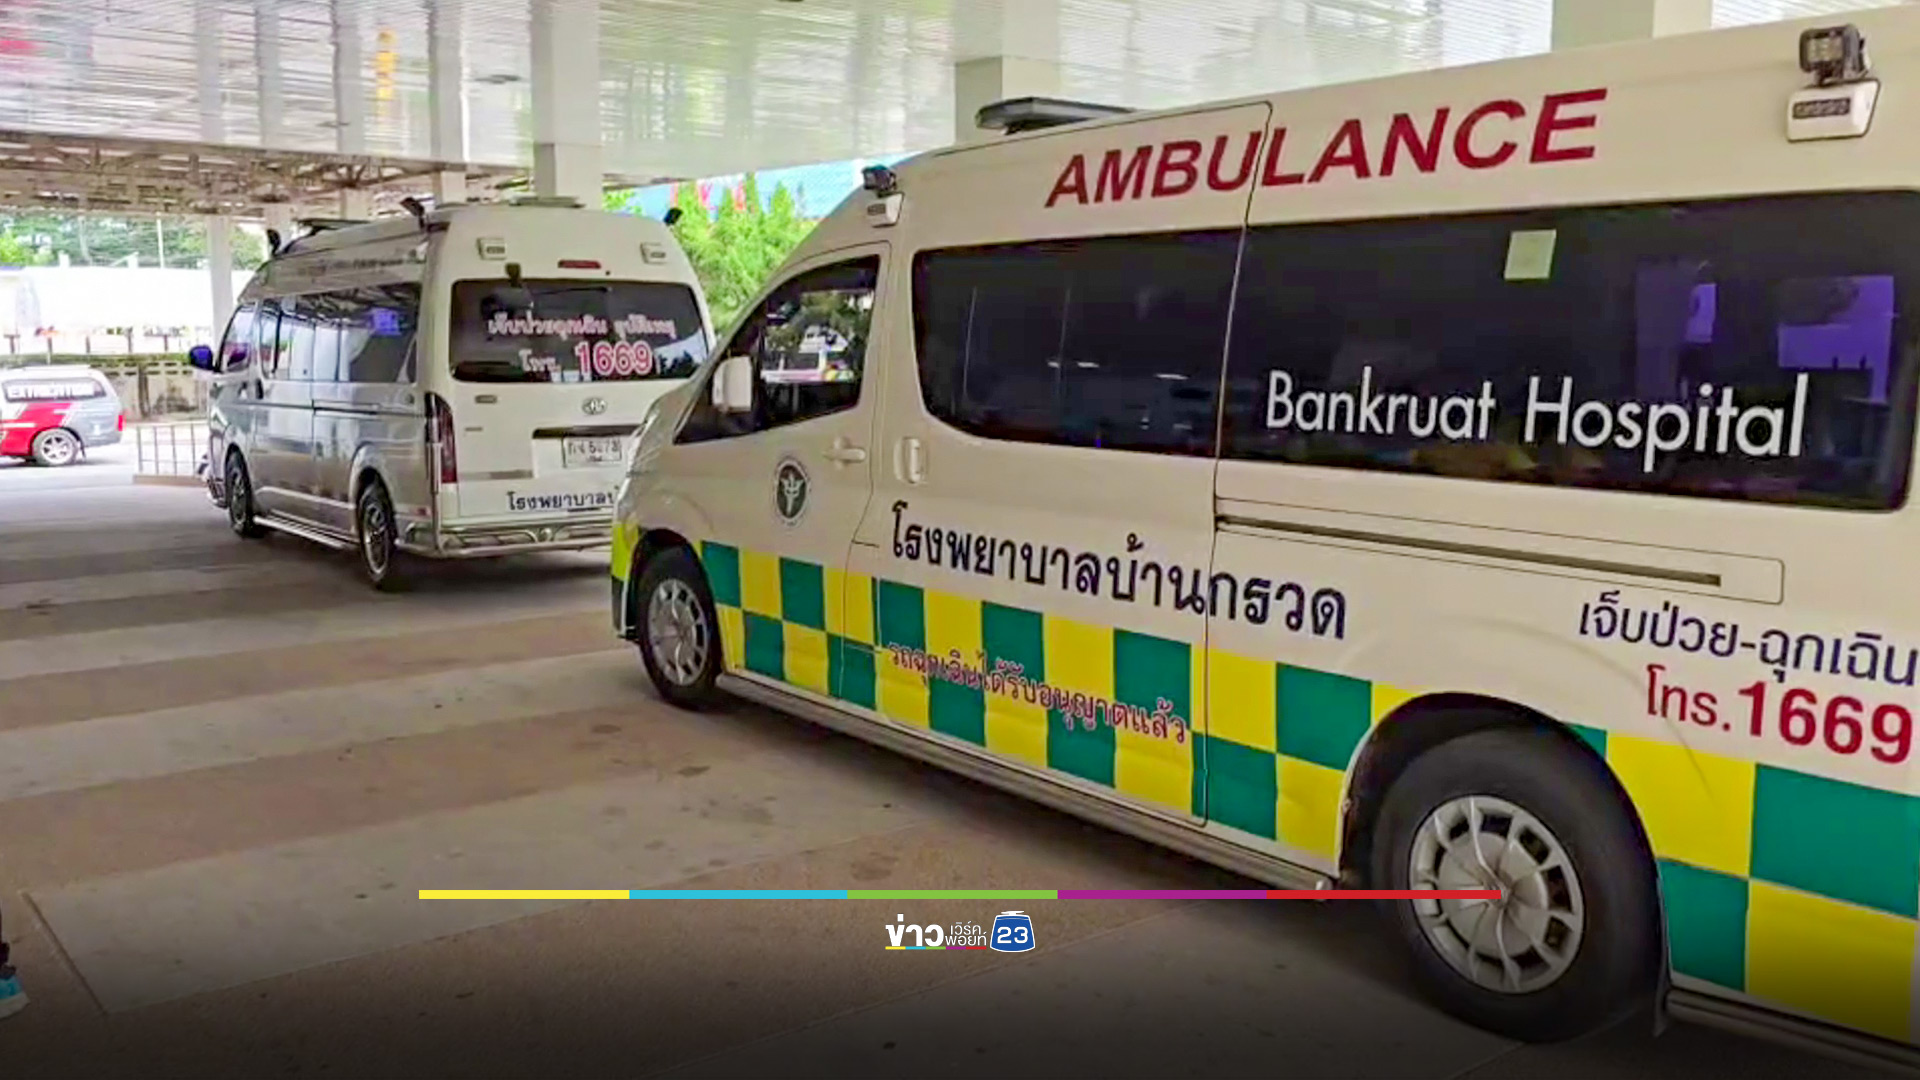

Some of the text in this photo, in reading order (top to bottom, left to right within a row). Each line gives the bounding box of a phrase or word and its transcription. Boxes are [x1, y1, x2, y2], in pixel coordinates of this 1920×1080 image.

[1045, 87, 1608, 208] AMBULANCE
[575, 340, 653, 376] 1669
[1266, 366, 1809, 473] Bankruat Hospital
[891, 501, 1347, 639] โรงพยาบาลบ้านกรวด
[1578, 589, 1919, 687] เจ็บป่วย-ฉุกเฉิน
[887, 642, 1188, 744] รถฉุกเฉินได้รับอนุญาตแล้ว
